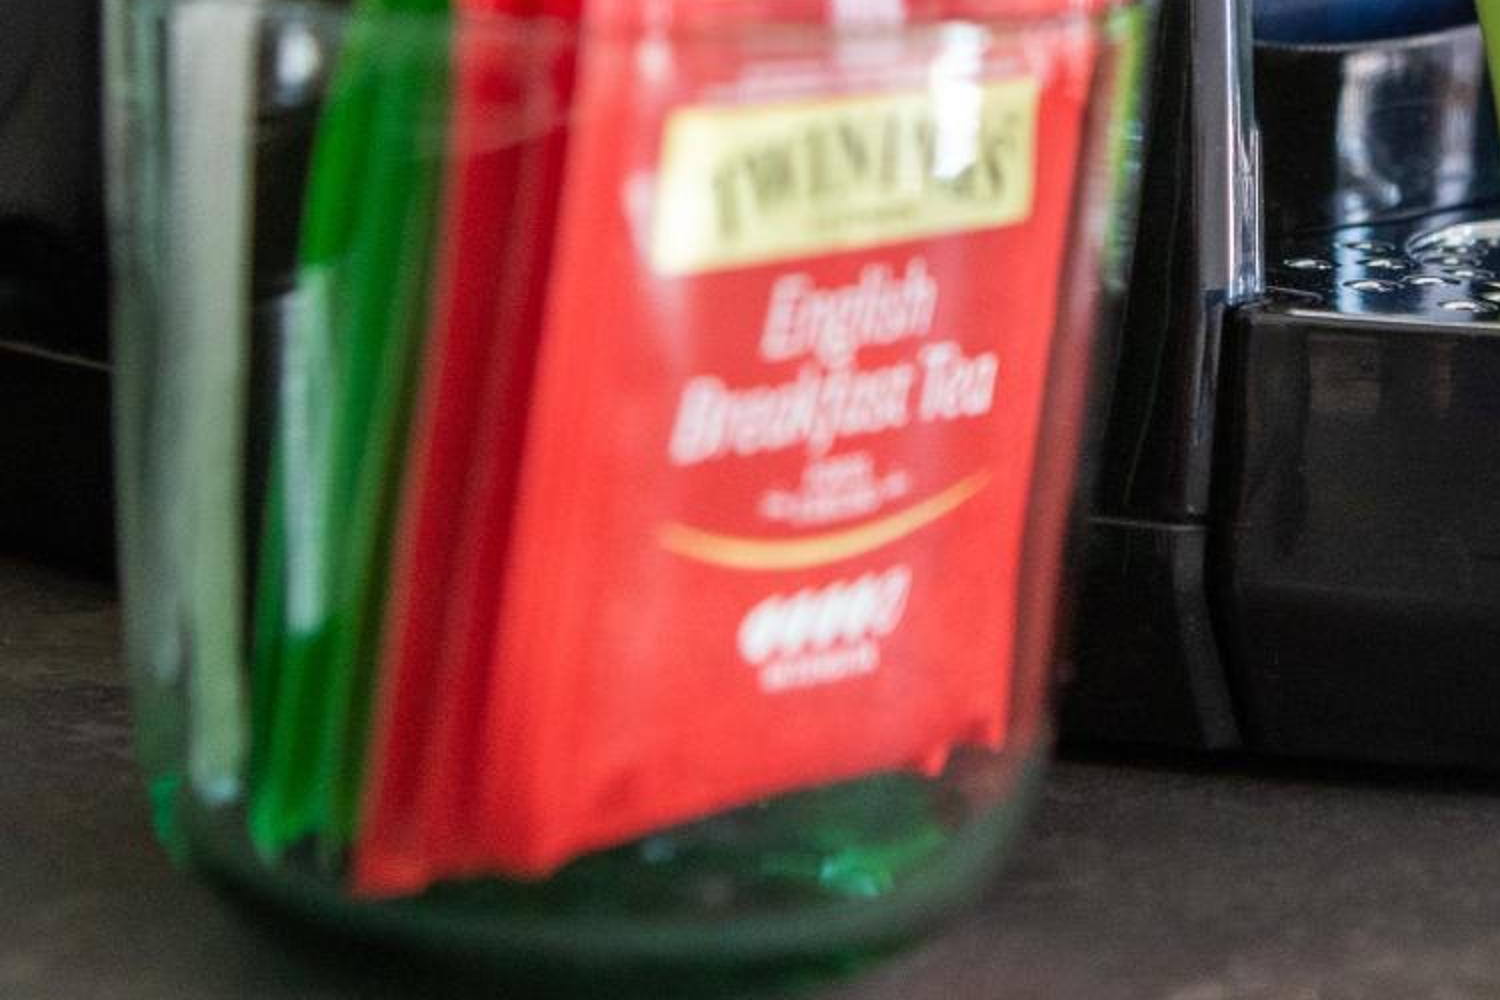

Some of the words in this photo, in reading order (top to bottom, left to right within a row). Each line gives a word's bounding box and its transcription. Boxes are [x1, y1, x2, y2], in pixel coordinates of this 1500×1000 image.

[763, 260, 936, 365] English
[669, 364, 913, 466] Breakfast
[918, 341, 998, 421] Tea
